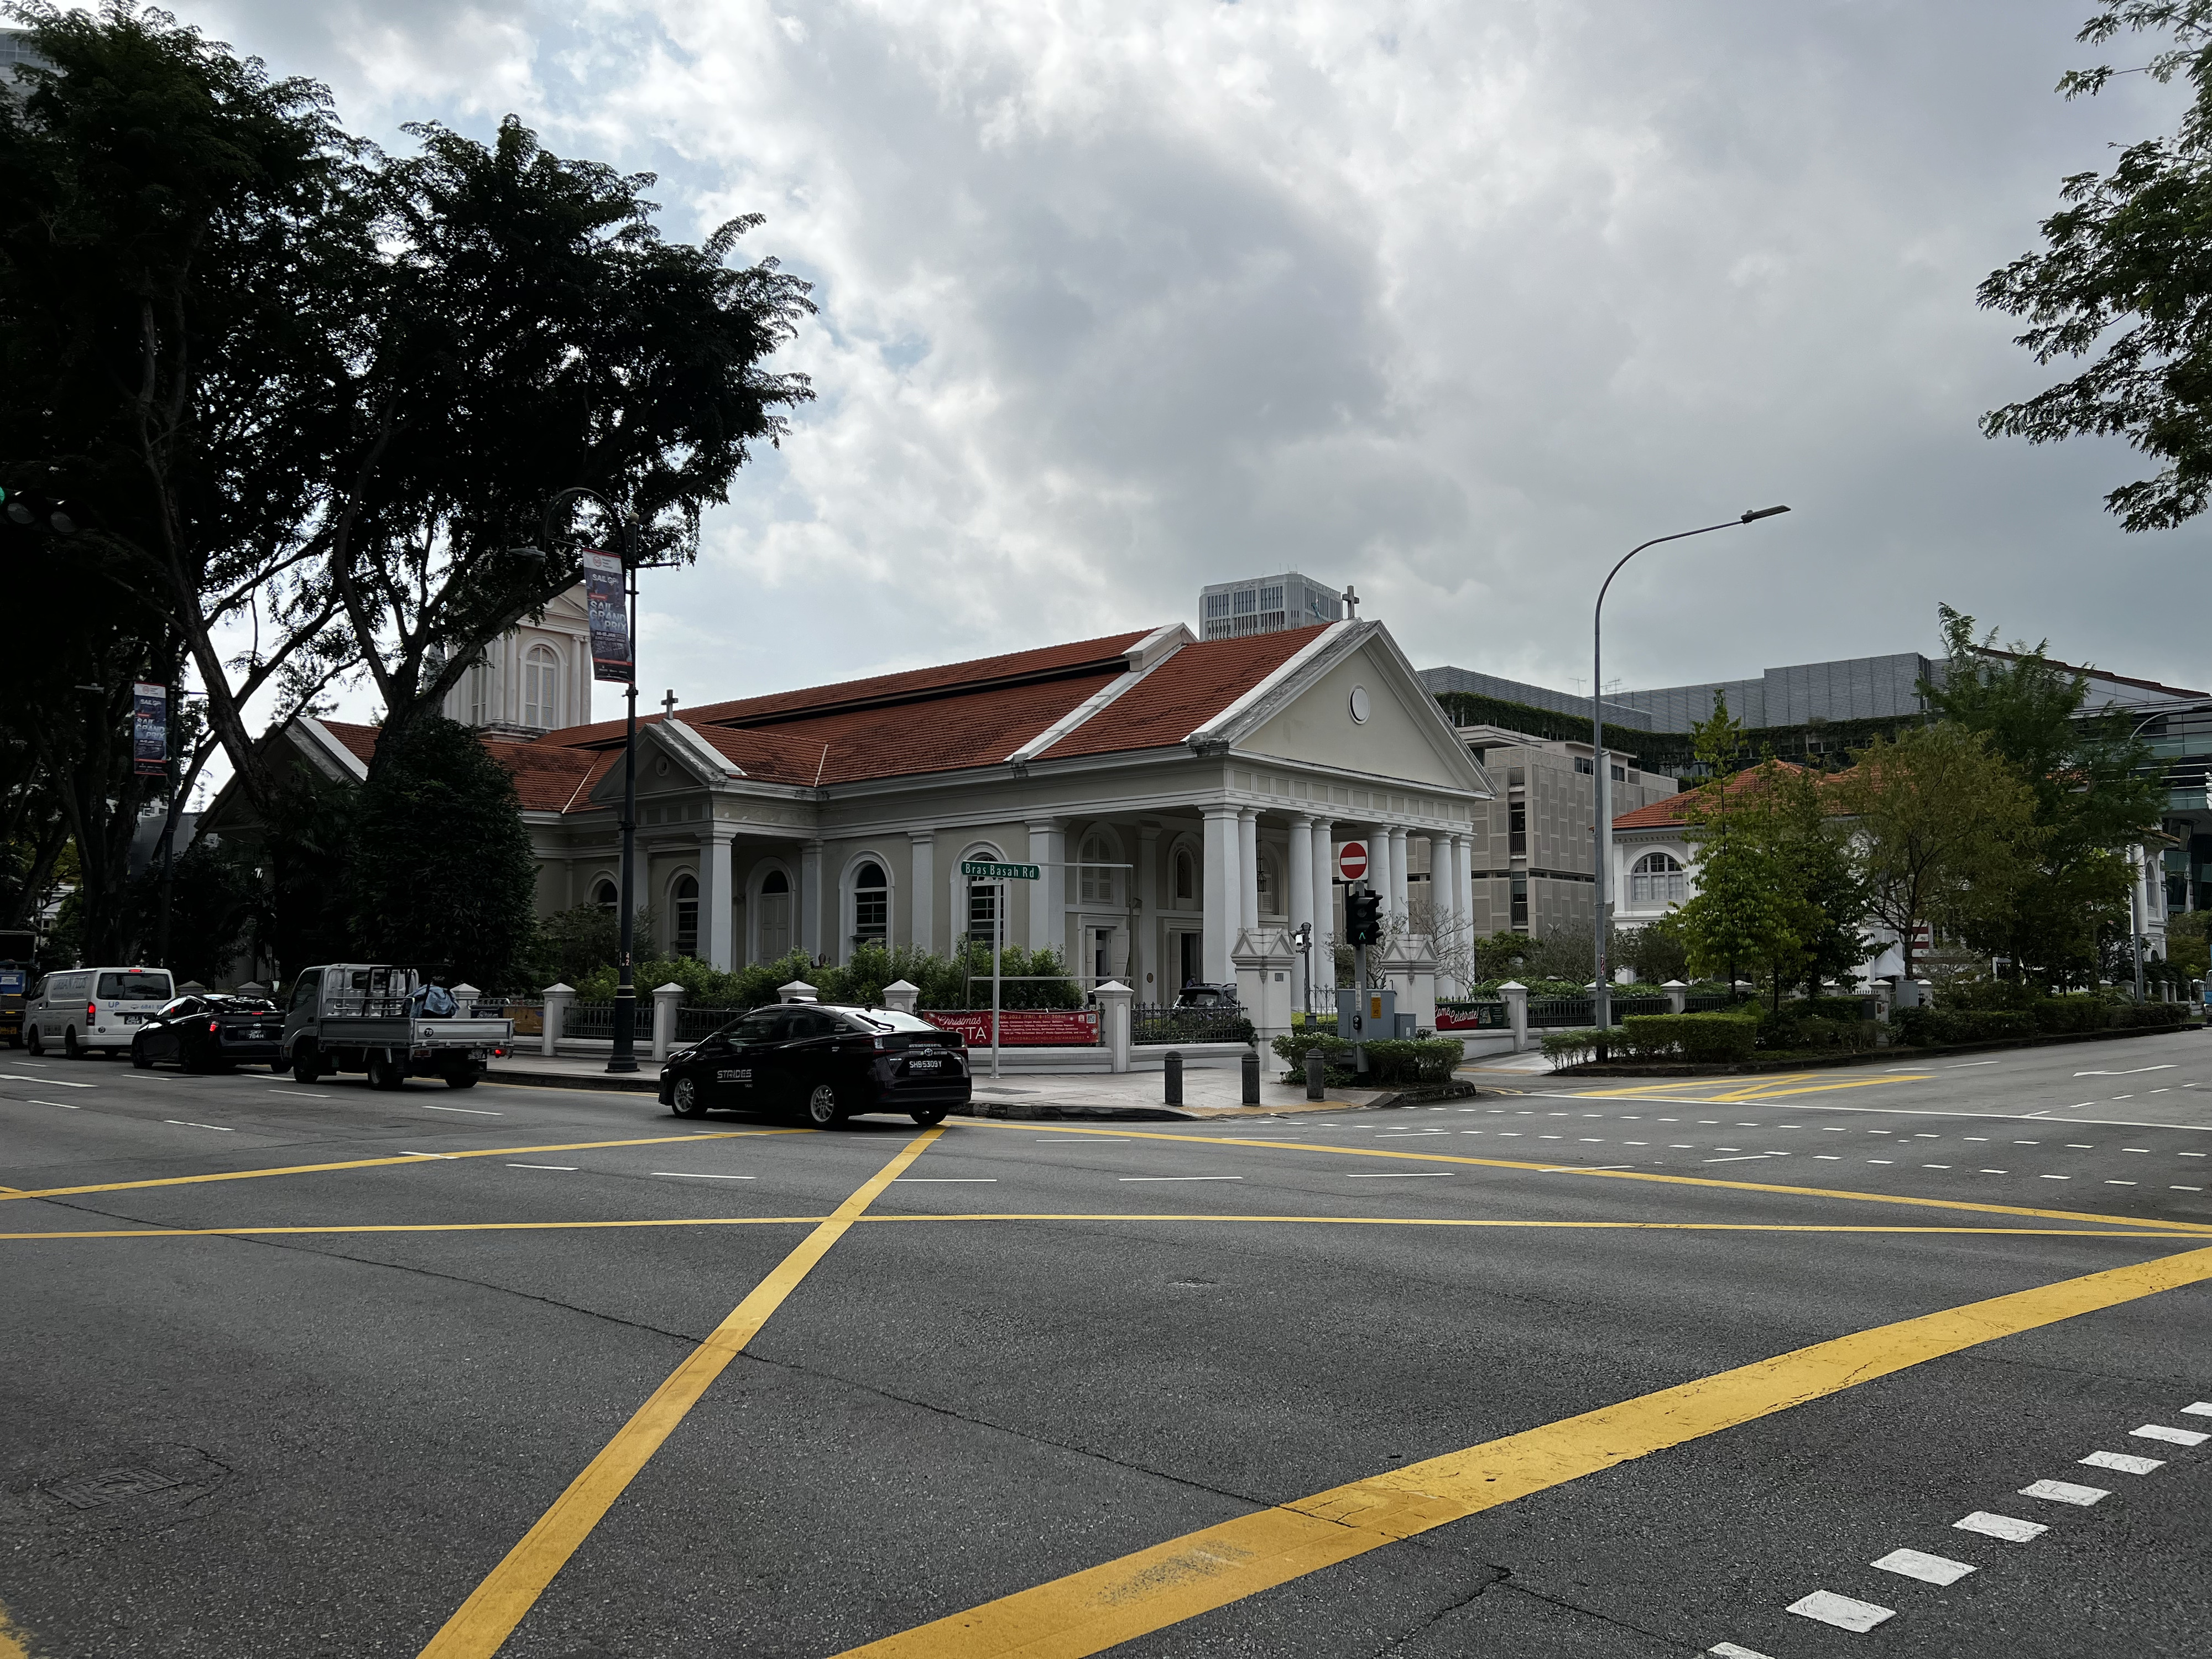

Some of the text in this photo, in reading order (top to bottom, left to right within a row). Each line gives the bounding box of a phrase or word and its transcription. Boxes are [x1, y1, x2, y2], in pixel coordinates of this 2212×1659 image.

[589, 601, 614, 613] SAIL
[589, 609, 626, 623] GRAND
[604, 620, 627, 632] PRIX
[966, 863, 1034, 878] Bras Basah Rd
[1434, 1005, 1450, 1019] Come
[1450, 1006, 1479, 1024] Celebrate!
[937, 1015, 982, 1026] Christmas
[717, 1069, 752, 1079] STRIDES
